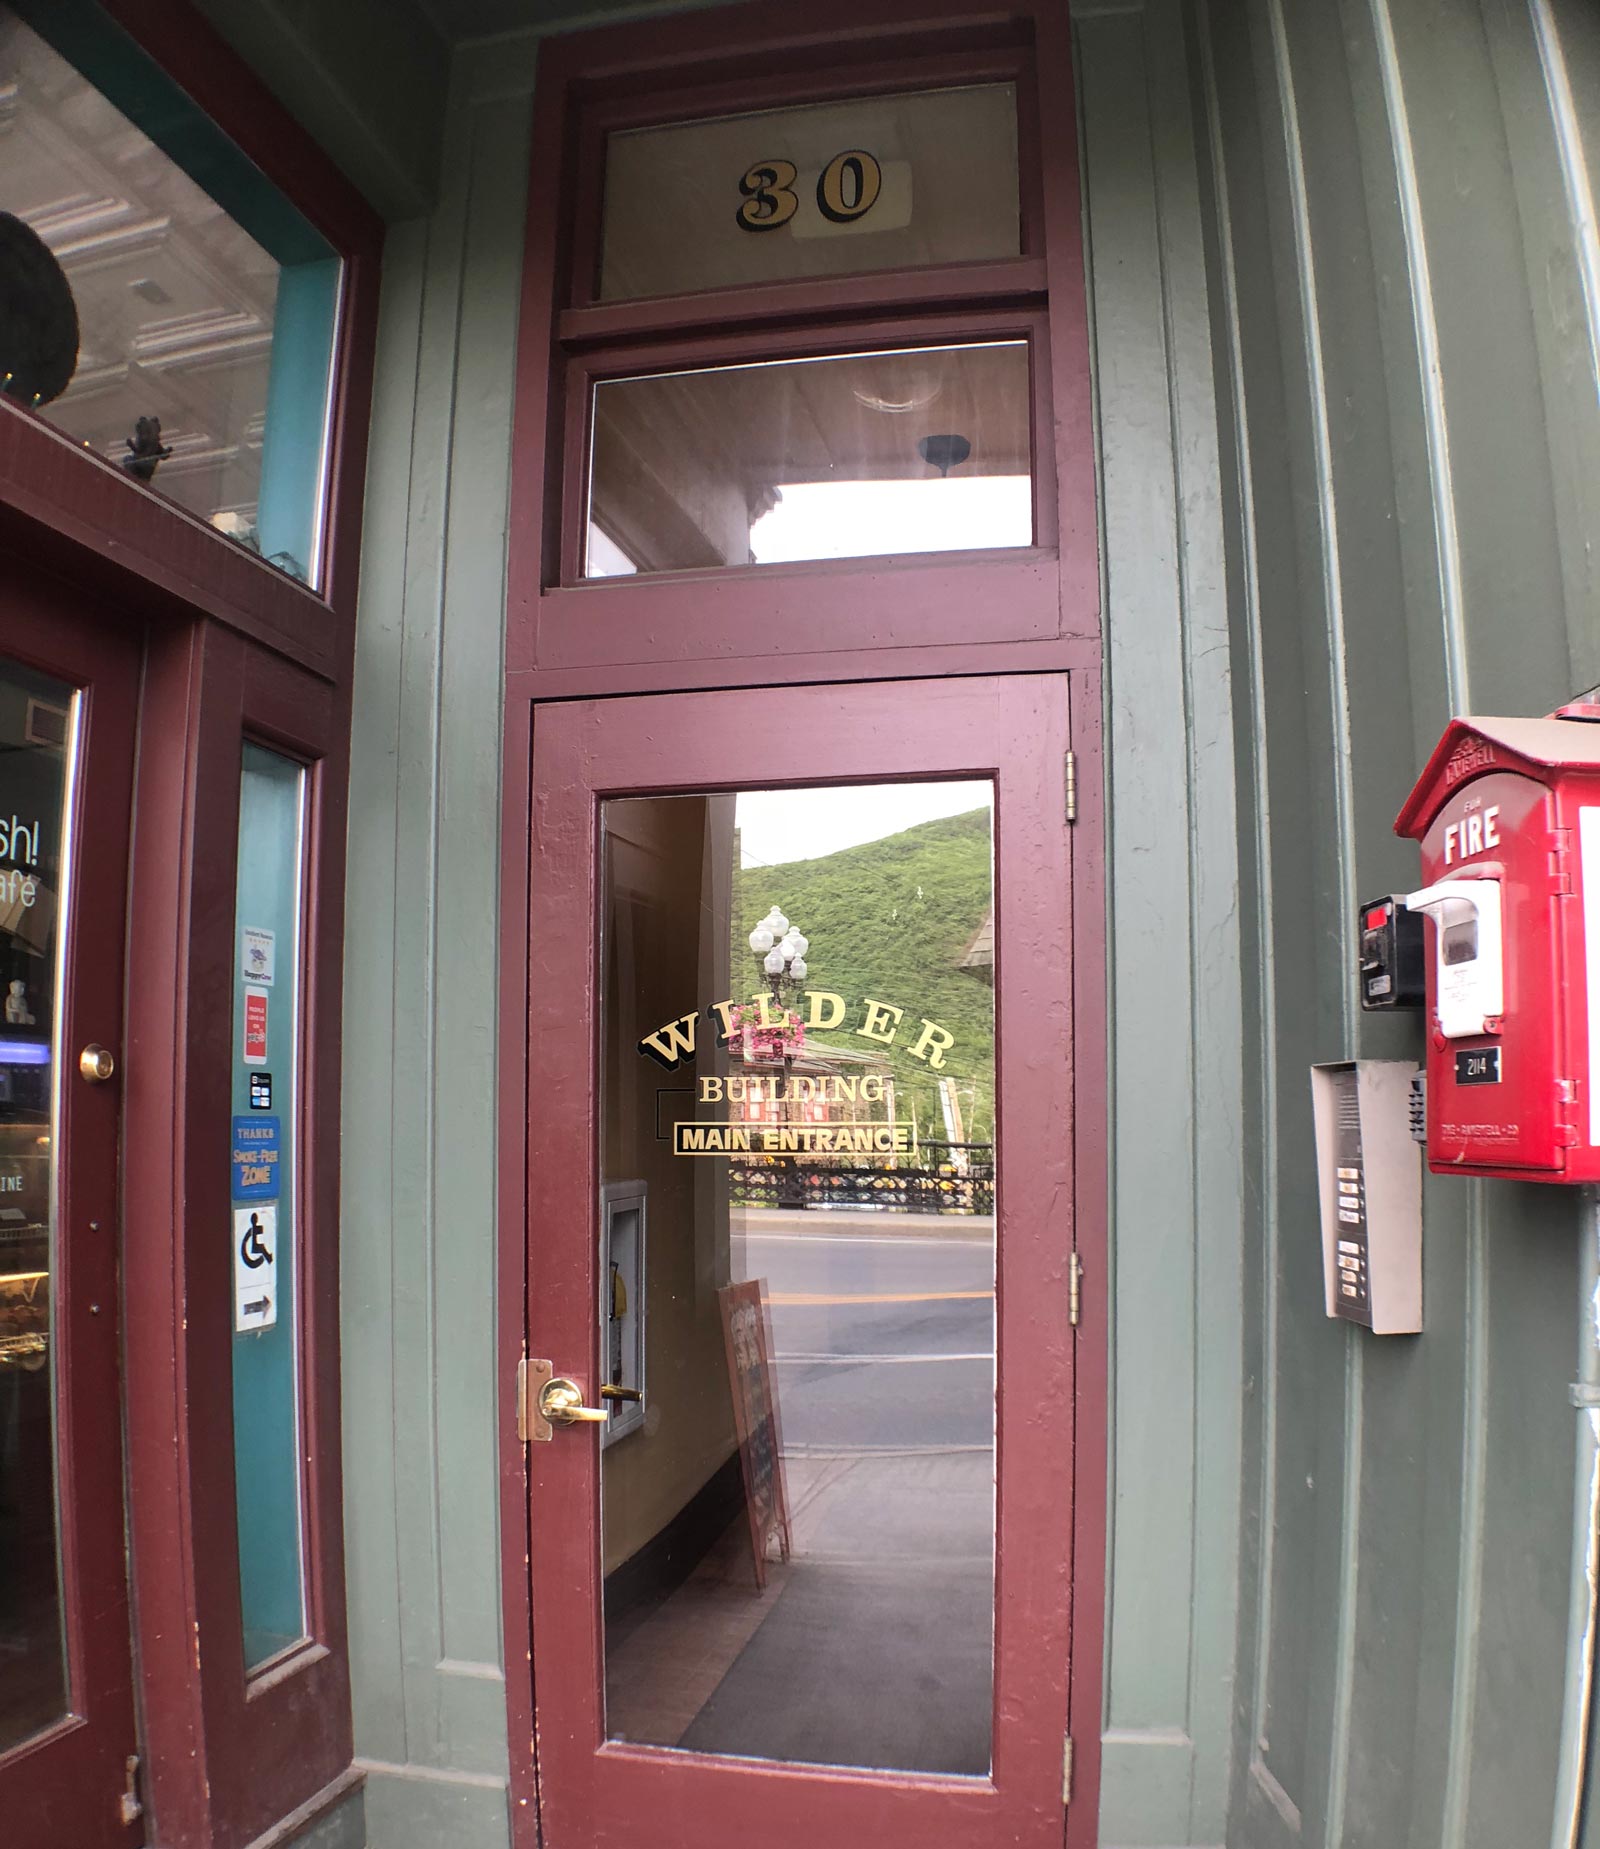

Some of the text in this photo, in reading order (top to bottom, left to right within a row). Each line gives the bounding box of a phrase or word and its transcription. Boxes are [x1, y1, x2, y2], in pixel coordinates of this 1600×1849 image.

[735, 149, 882, 233] 30
[1443, 805, 1501, 866] FIRE
[638, 990, 956, 1073] WILDER
[1467, 1057, 1487, 1076] 2114
[698, 1074, 887, 1103] BUILDING
[682, 1127, 909, 1152] MAIN ENTRANCE
[241, 1165, 271, 1187] ZONE
